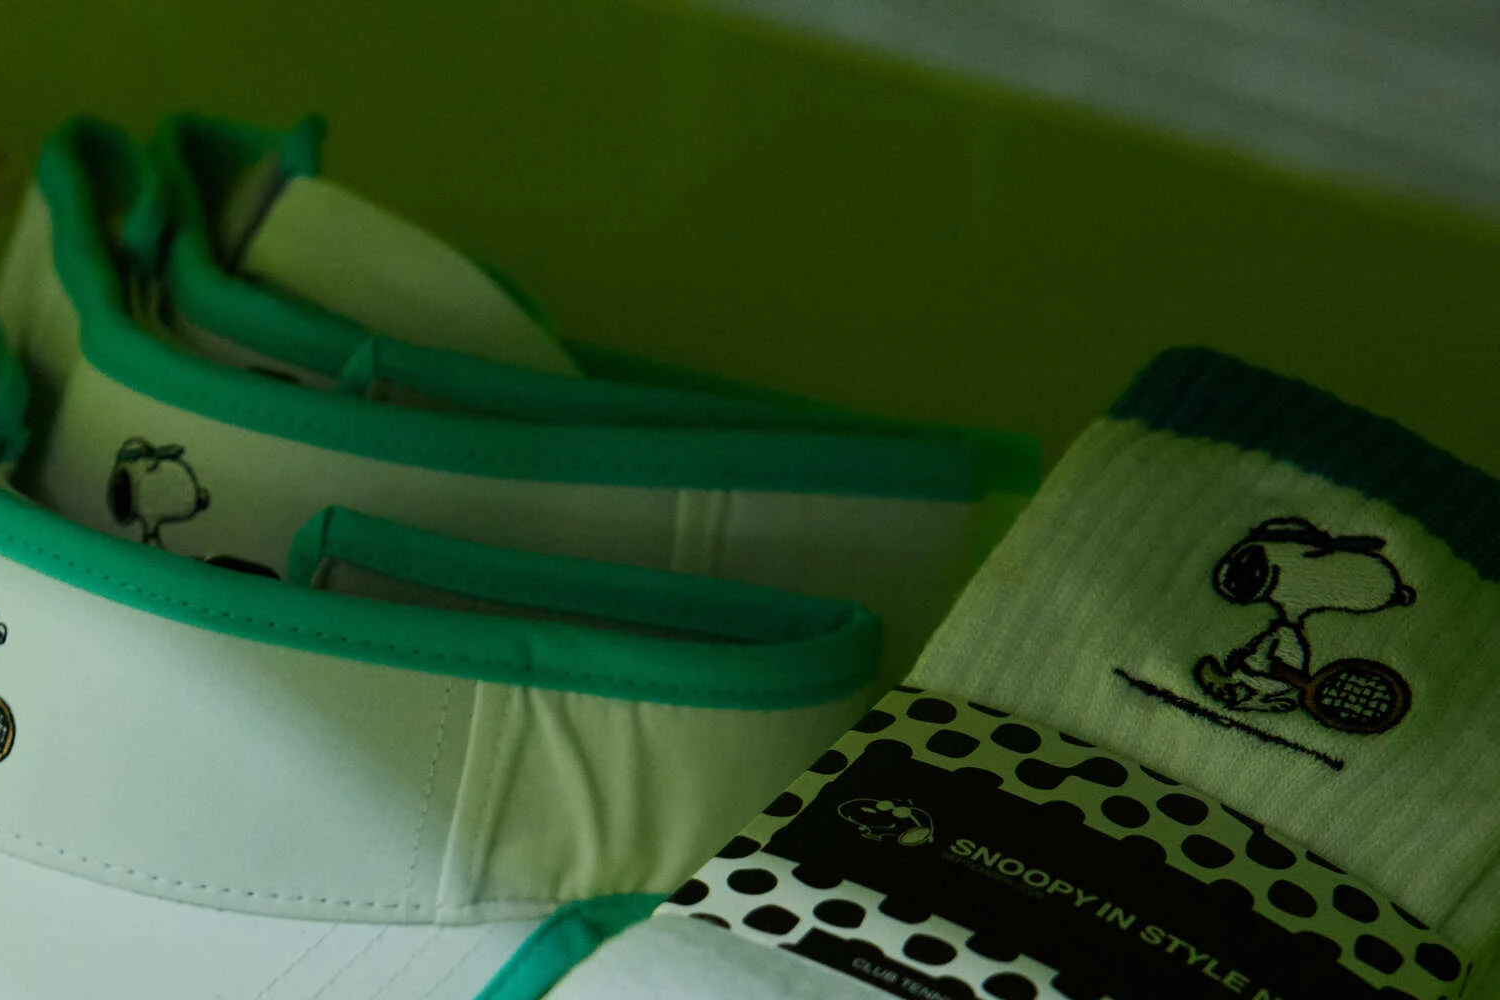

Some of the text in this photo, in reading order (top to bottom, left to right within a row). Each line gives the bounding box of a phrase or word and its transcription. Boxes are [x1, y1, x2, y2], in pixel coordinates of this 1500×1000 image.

[949, 838, 1100, 908] SNOOPY
[1095, 901, 1139, 931] IN
[1139, 924, 1252, 994] STYLE
[851, 957, 899, 984] CLUB
